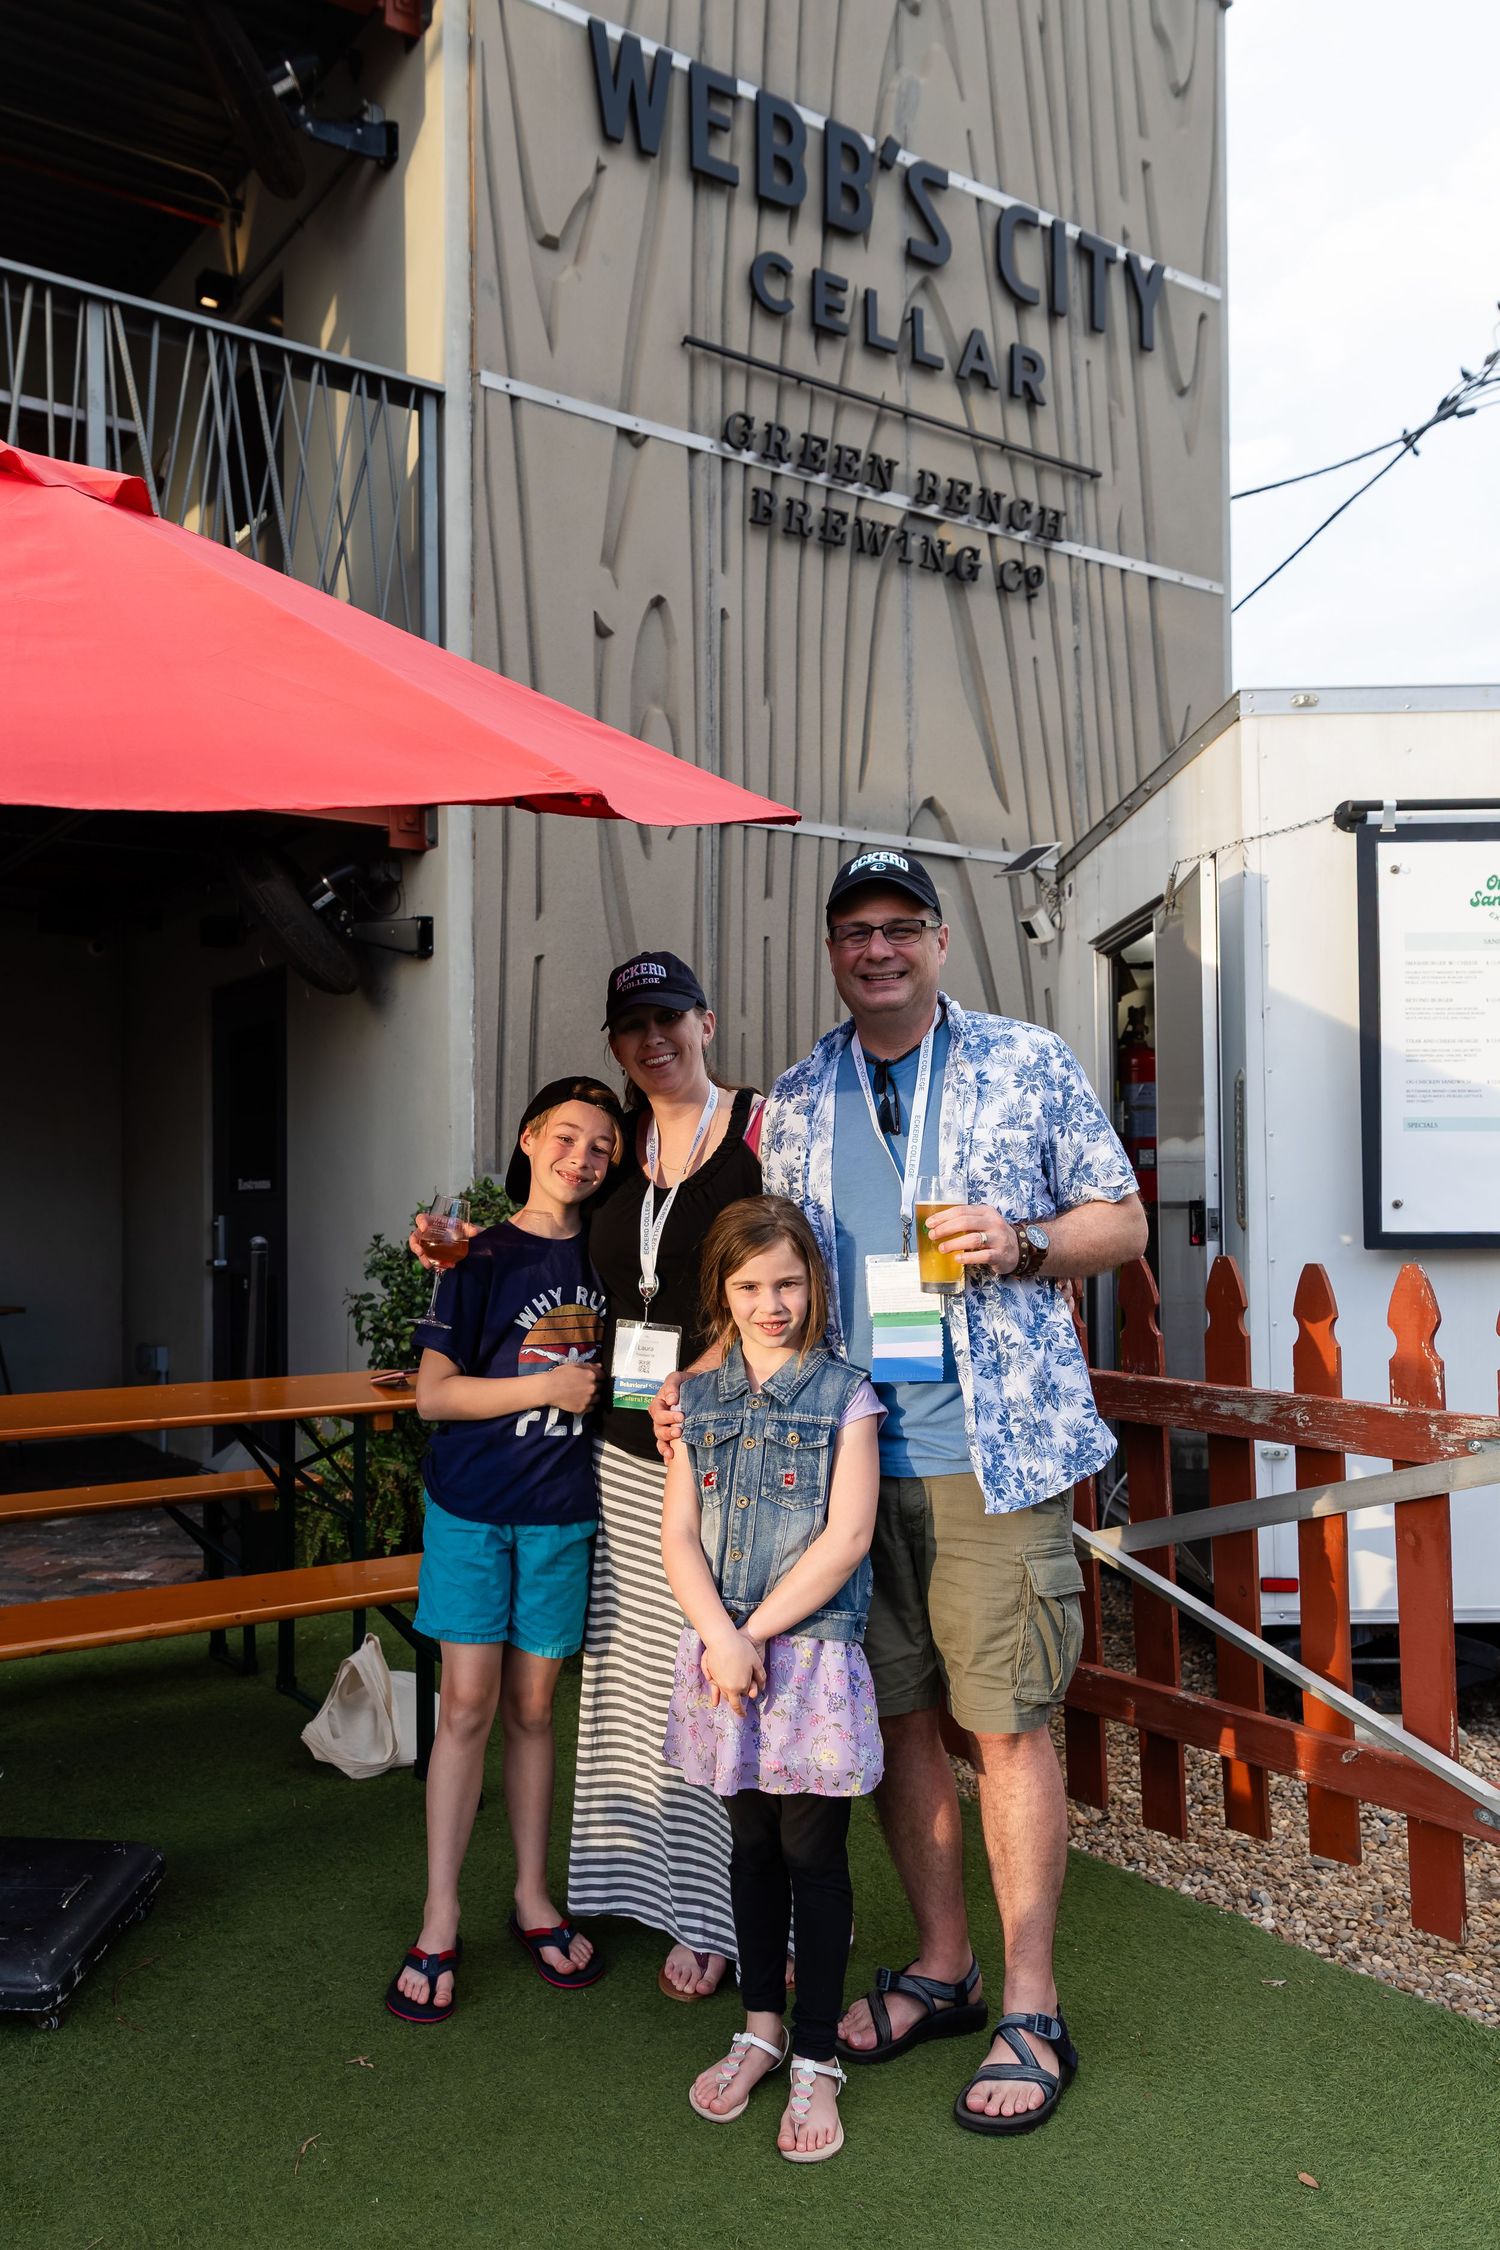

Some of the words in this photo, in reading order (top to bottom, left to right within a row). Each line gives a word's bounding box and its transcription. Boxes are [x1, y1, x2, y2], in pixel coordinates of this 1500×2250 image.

[588, 17, 952, 268] WEBB'S
[999, 205, 1166, 352] CITY
[750, 252, 1047, 405] CELLAR
[722, 411, 899, 493] GREEN
[912, 467, 1067, 542] BENCH
[750, 486, 982, 583] BREWING
[848, 851, 910, 876] ECKERD
[616, 962, 667, 991] ECKERD
[621, 977, 660, 992] COLLEGE
[918, 1059, 927, 1092] COLLEGE
[912, 1114, 921, 1144] ECKERD
[908, 1145, 918, 1179] COLLEGE
[513, 1286, 562, 1330] WHY
